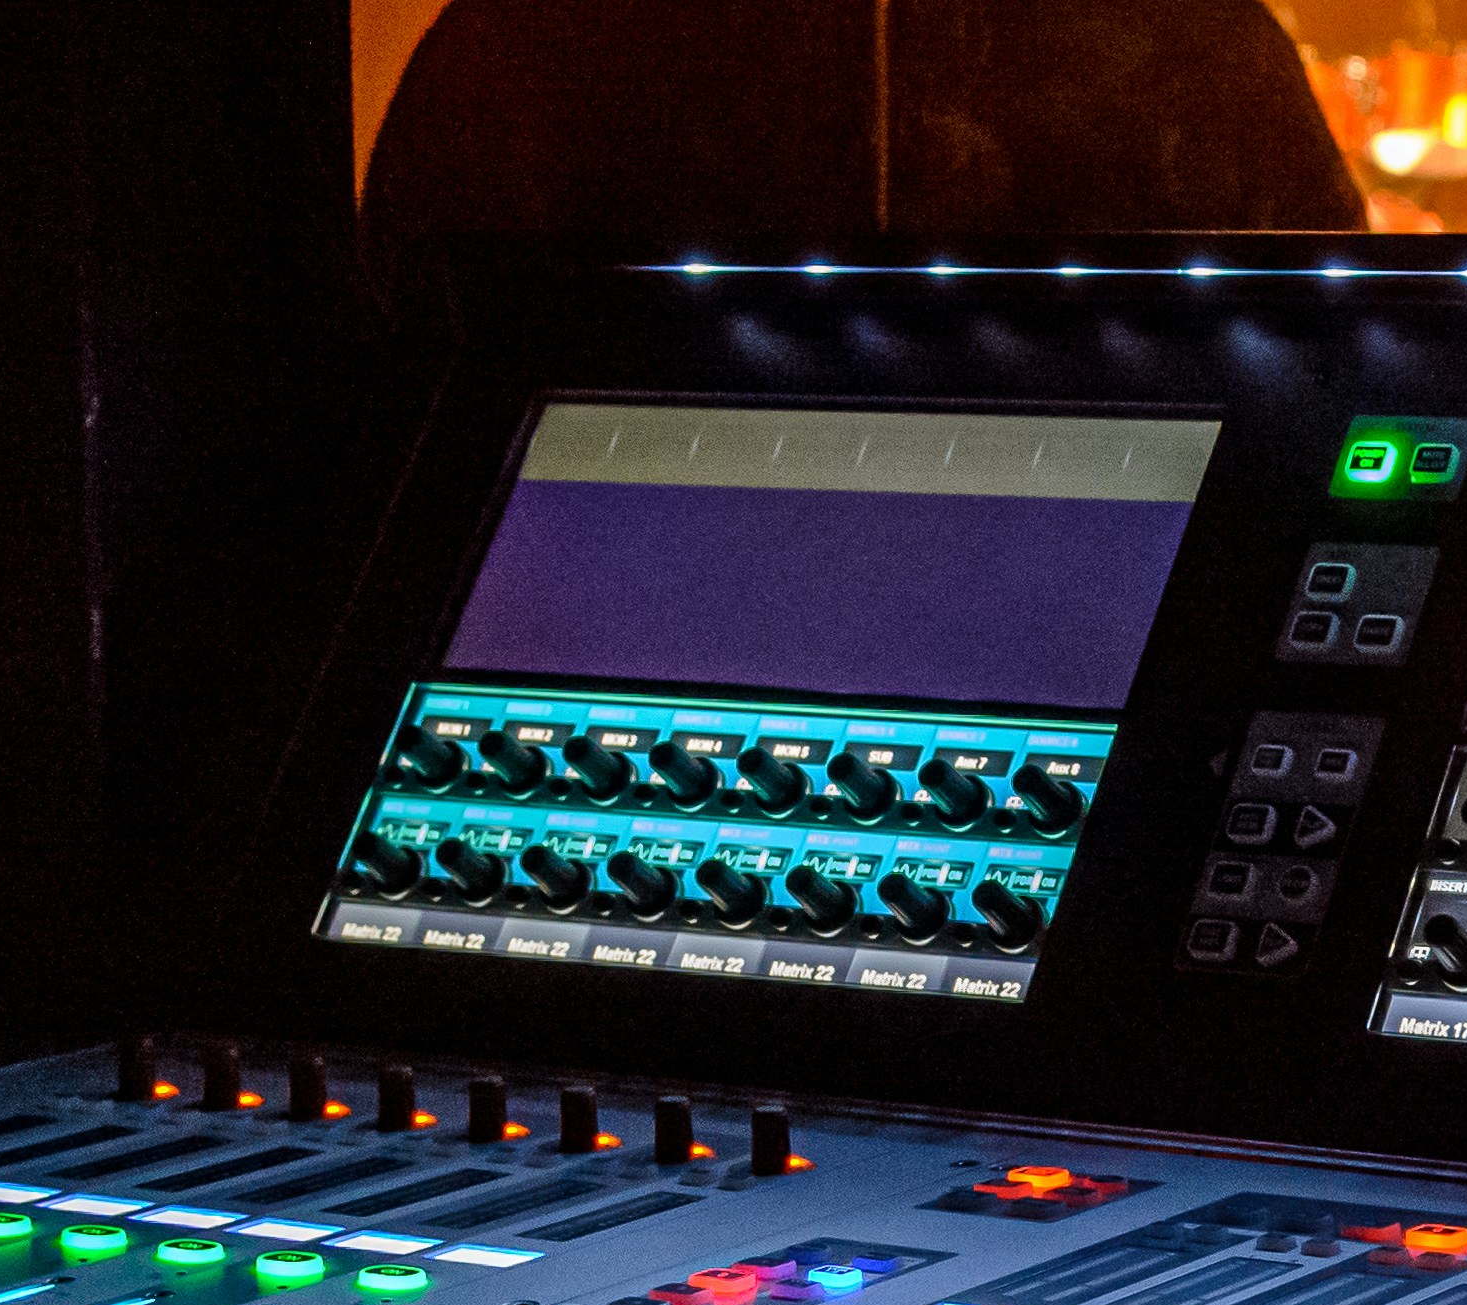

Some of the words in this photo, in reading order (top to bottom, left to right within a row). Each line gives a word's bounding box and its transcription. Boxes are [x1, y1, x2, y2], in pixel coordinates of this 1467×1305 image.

[868, 749, 894, 765] SUB
[1046, 760, 1071, 775] Aux
[593, 945, 636, 963] Matrix
[637, 950, 657, 966] 22
[681, 953, 723, 972] Matrix
[724, 957, 745, 974] 22
[769, 961, 813, 980] Matrix
[814, 965, 835, 982] 22
[861, 969, 905, 988] Matrix
[906, 973, 927, 990] 22
[954, 977, 999, 996] Matrix
[1000, 982, 1021, 998] 22
[1399, 1018, 1450, 1038] Matrix
